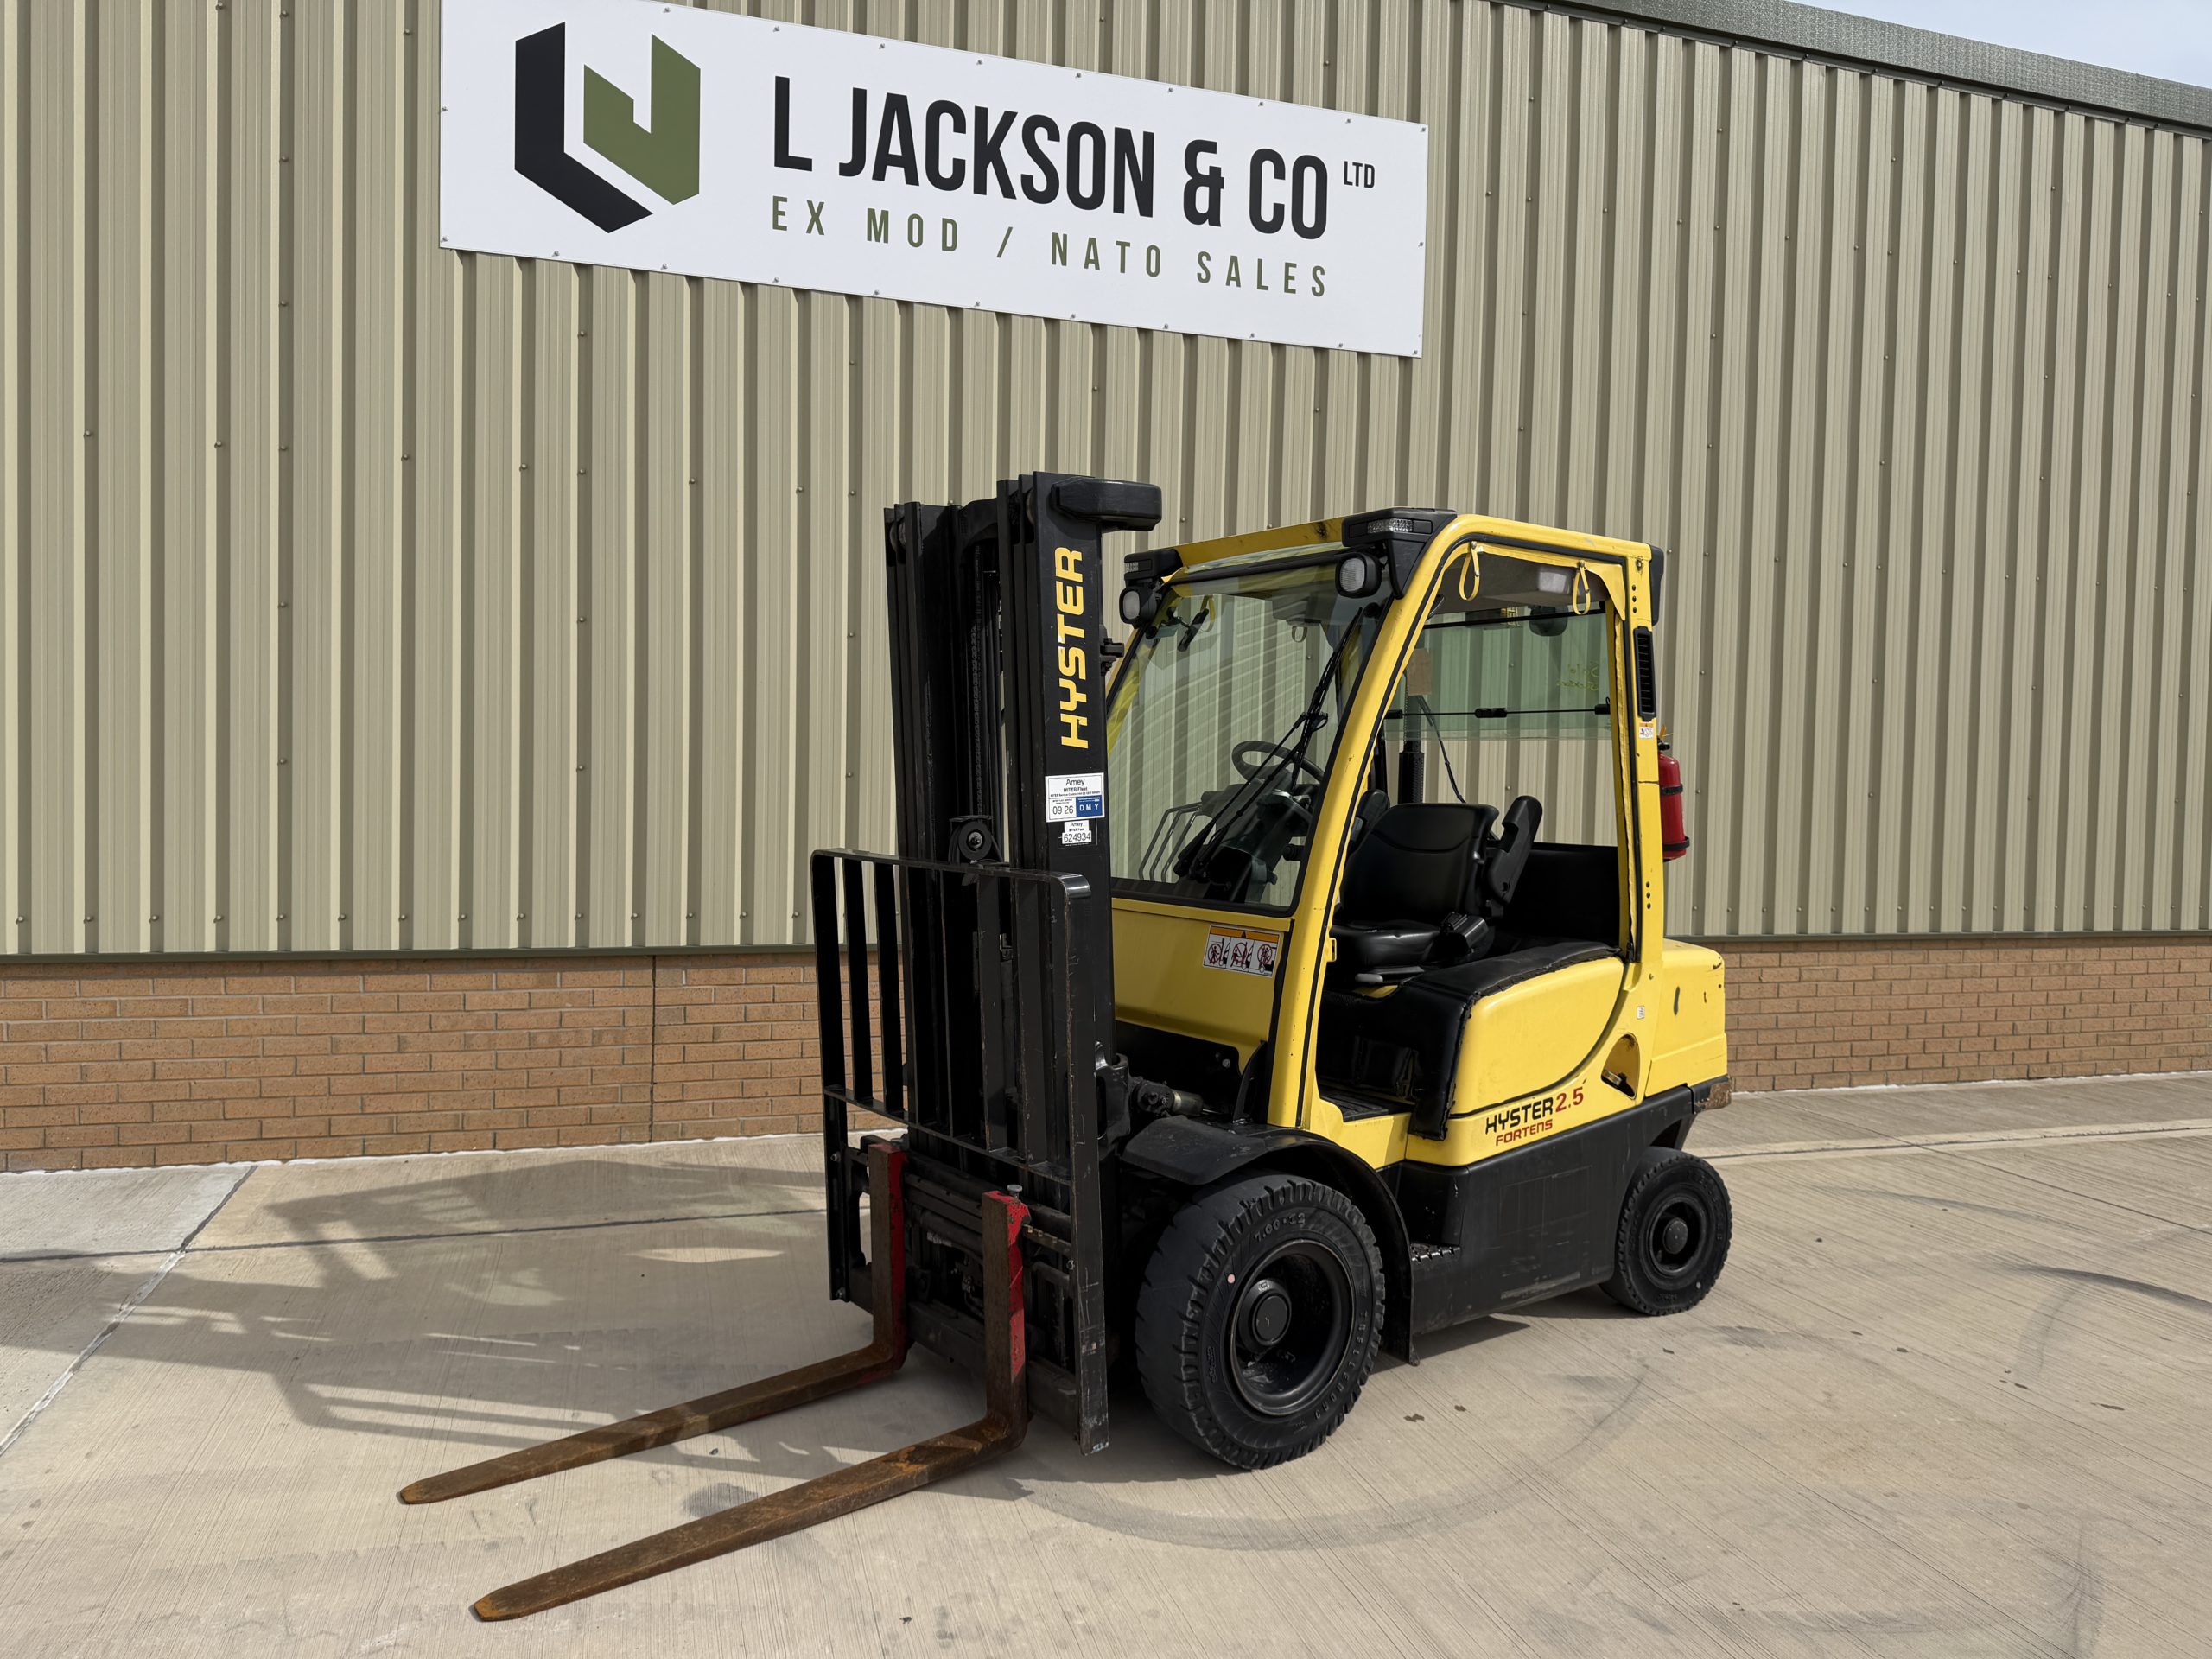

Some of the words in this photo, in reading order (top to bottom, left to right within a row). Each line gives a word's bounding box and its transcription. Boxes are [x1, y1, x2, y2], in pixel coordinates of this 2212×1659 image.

[774, 75, 812, 171] L
[838, 86, 1154, 218] JACKSON
[1183, 138, 1224, 227] &
[1249, 148, 1328, 240] CO
[1343, 161, 1376, 189] LTD
[772, 195, 825, 236] EX
[867, 207, 958, 252] MOD
[1051, 232, 1161, 277] NATO
[1196, 251, 1326, 297] SALES
[1054, 547, 1090, 749] HYSTER
[1052, 805, 1063, 815] 09
[1064, 805, 1074, 814] 26
[1063, 832, 1090, 842] 624934
[1485, 1097, 1554, 1135] HYSTER
[1555, 1086, 1584, 1113] 2.5
[1496, 1118, 1554, 1147] FORTENS
